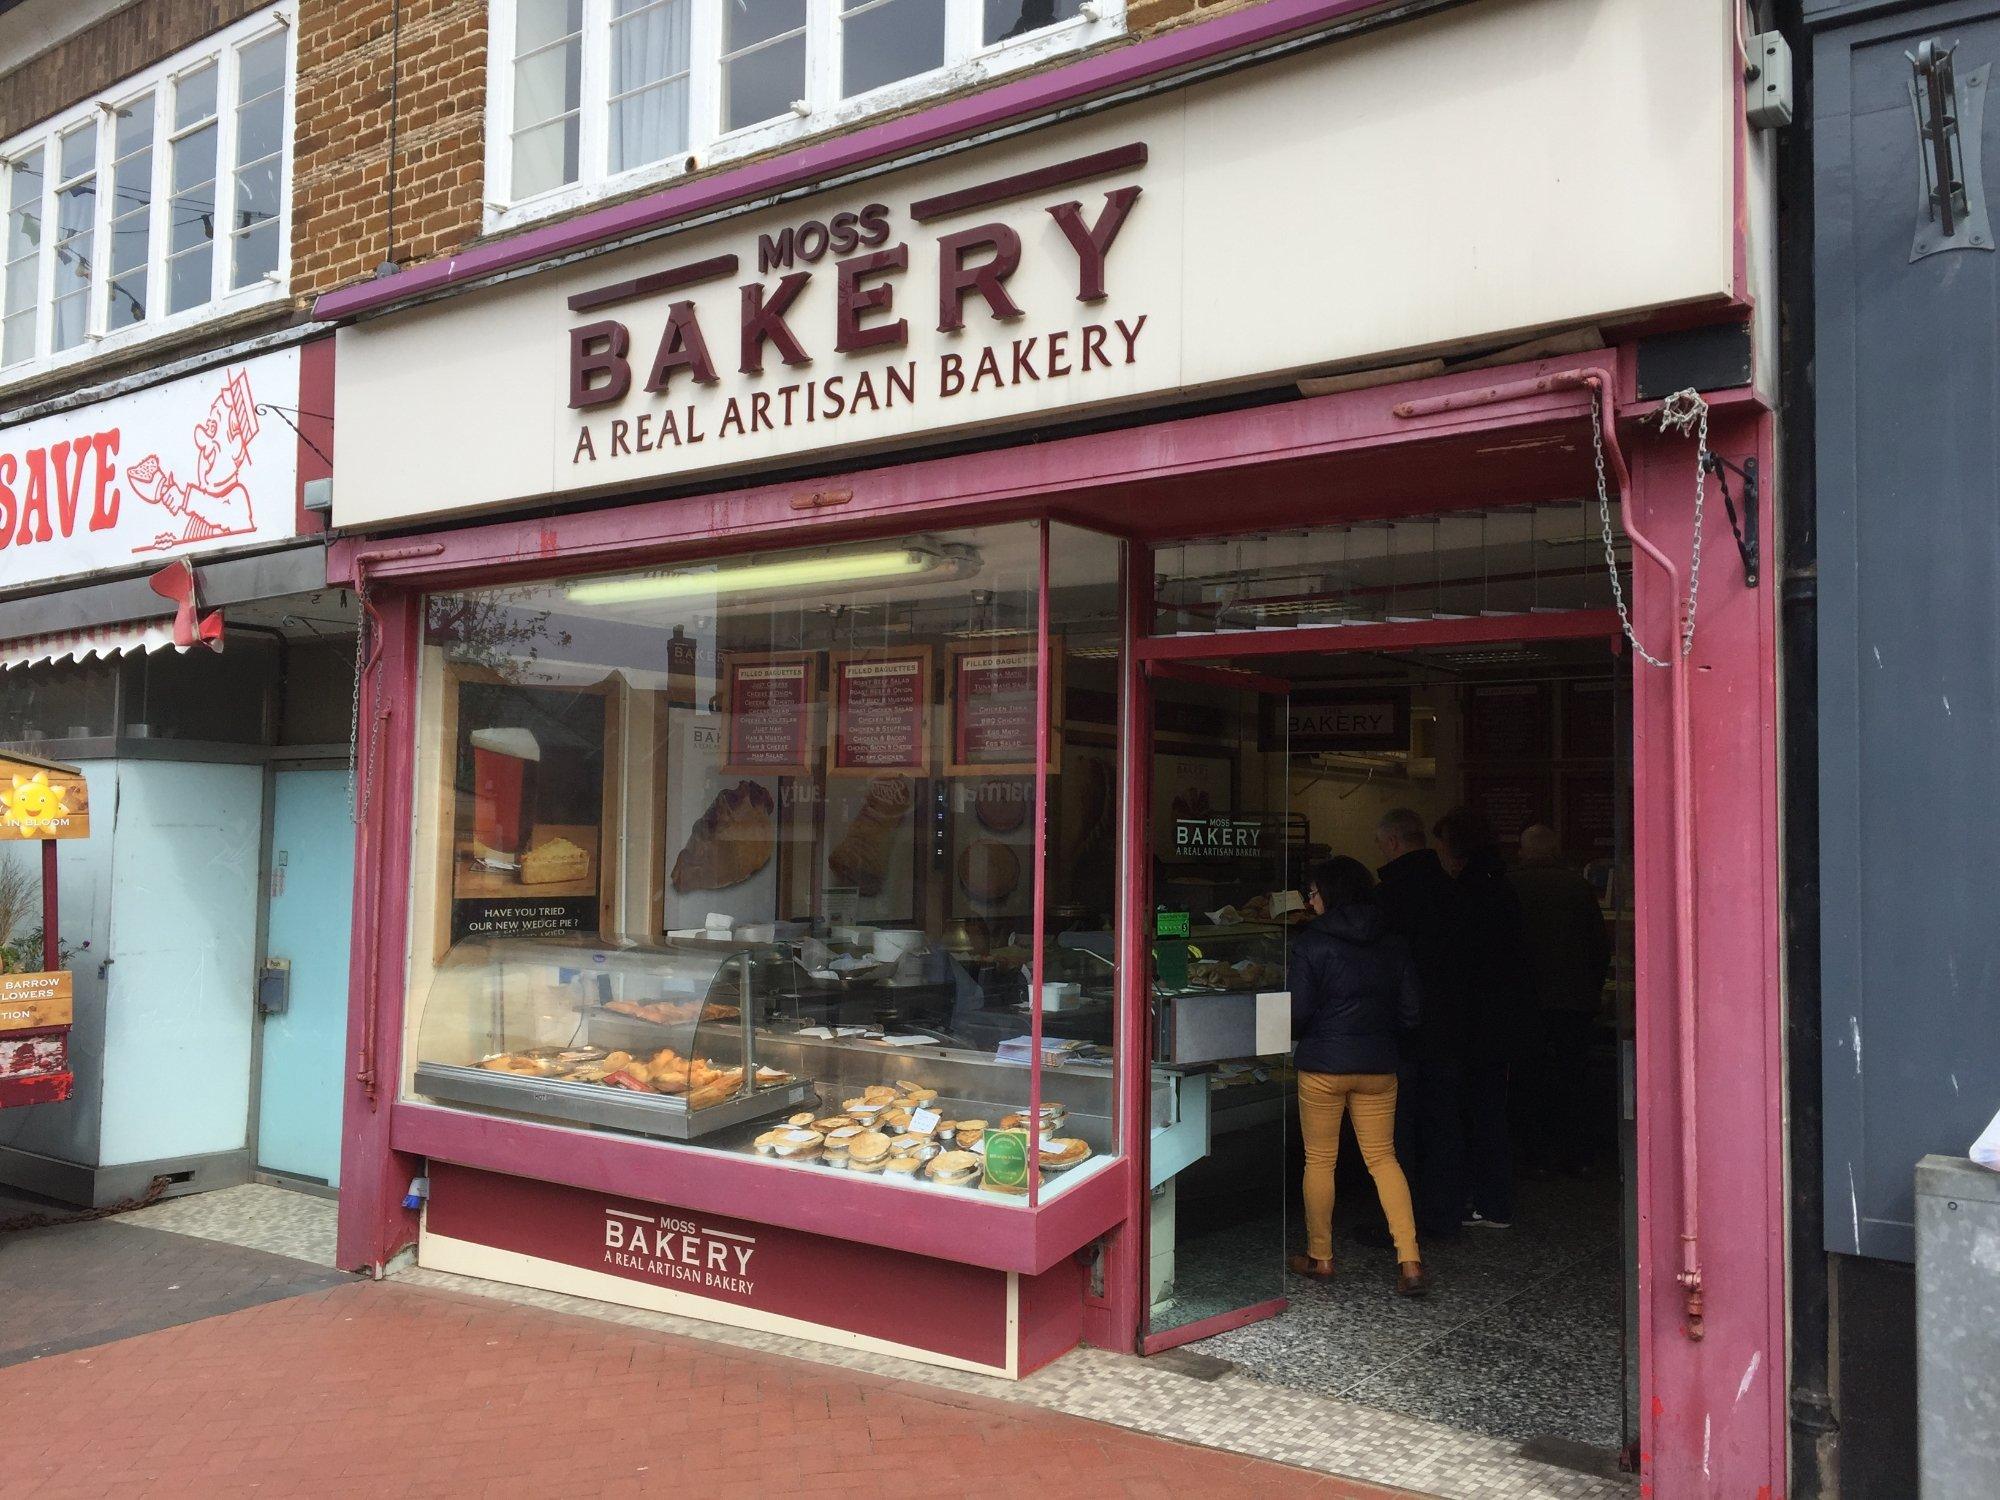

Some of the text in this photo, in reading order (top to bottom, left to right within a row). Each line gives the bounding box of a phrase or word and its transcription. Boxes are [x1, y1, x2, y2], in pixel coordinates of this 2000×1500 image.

[757, 203, 890, 274] MOSS
[567, 185, 1144, 410] BAKERY
[572, 315, 1148, 464] A REAL ARTISAN BAKERY
[848, 667, 873, 675] FILLED
[1289, 714, 1383, 733] BAKERY
[8, 818, 70, 827] IN BLOOM
[1209, 818, 1230, 827] MOSS
[1176, 826, 1260, 846] BAKERY
[1176, 847, 1261, 857] A REAL ARTISAN BAKERY
[484, 907, 565, 917] HAVE YOU TRIED
[469, 921, 493, 931] OUR
[495, 921, 519, 929] NEW
[522, 919, 557, 929] WEDGE
[559, 919, 572, 927] PIE
[5, 978, 60, 990] BARROW
[0, 989, 54, 1001] LOWERS
[660, 1216, 696, 1235] MOSS
[605, 1219, 754, 1276] BAKERY
[604, 1250, 754, 1295] A REAL ARTISAN BAKERY
